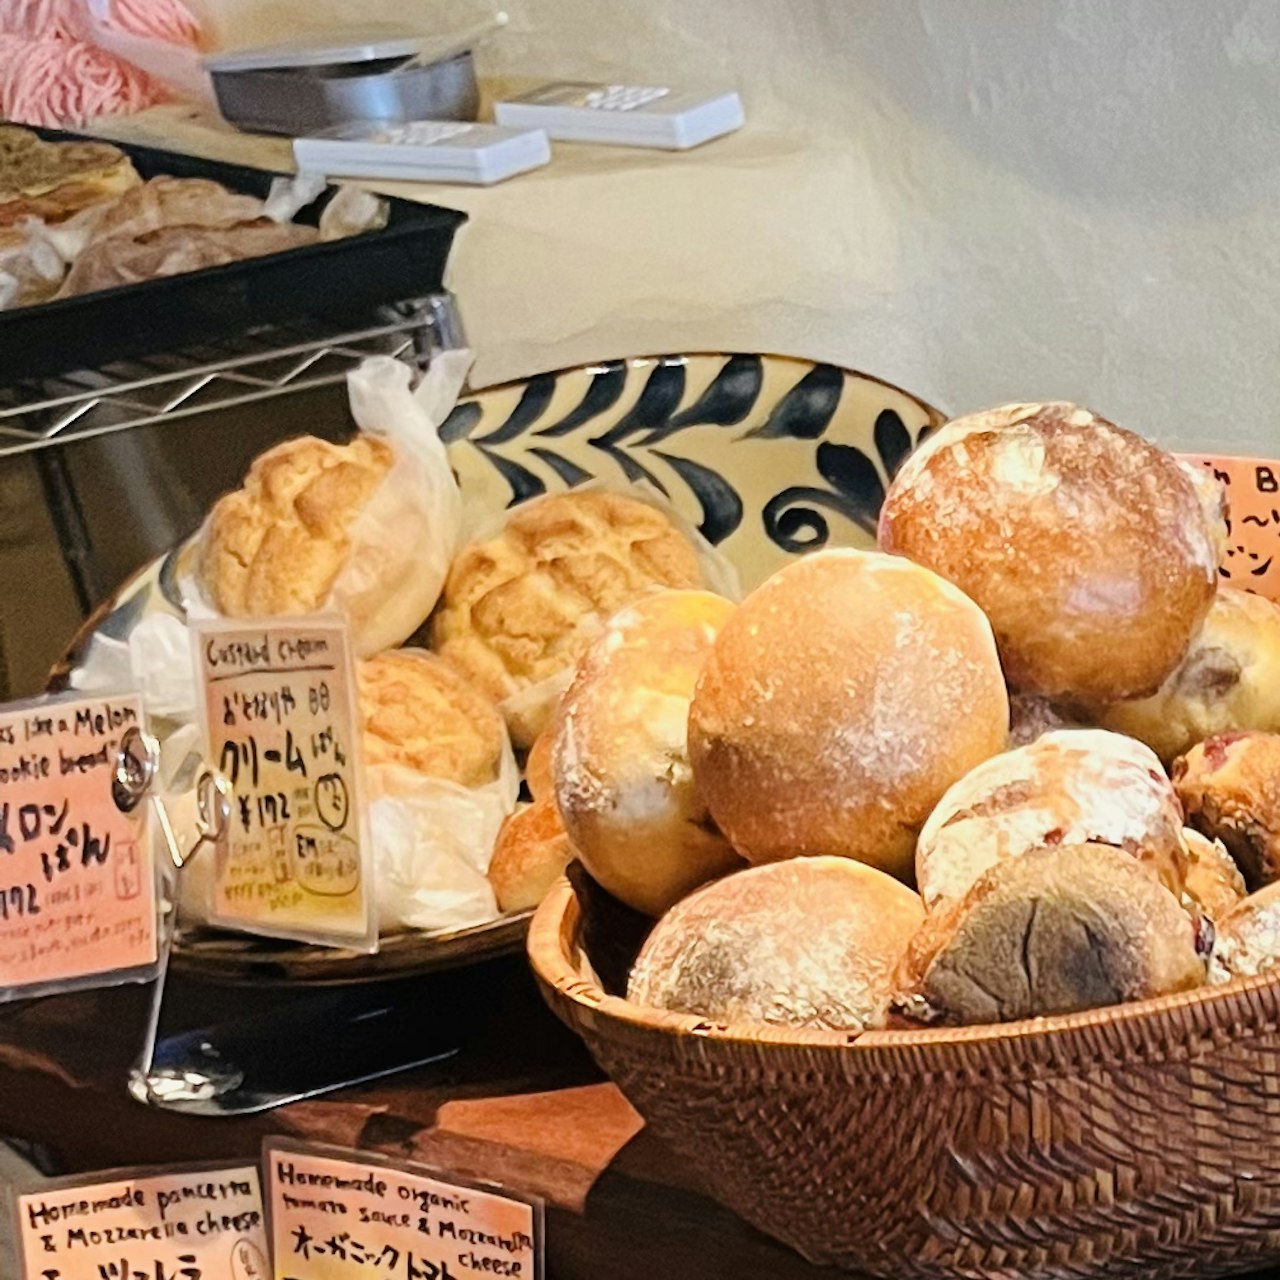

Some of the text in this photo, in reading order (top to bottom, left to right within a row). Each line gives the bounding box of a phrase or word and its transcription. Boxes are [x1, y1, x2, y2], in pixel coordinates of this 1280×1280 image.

[75, 705, 137, 736] Melon
[277, 1162, 471, 1214] Homemade organic
[28, 1186, 145, 1229] Homemade
[358, 1207, 412, 1228] sauce
[67, 1222, 189, 1250] Mozzarella
[196, 1209, 261, 1236] cheese
[458, 1251, 523, 1278] cheese
